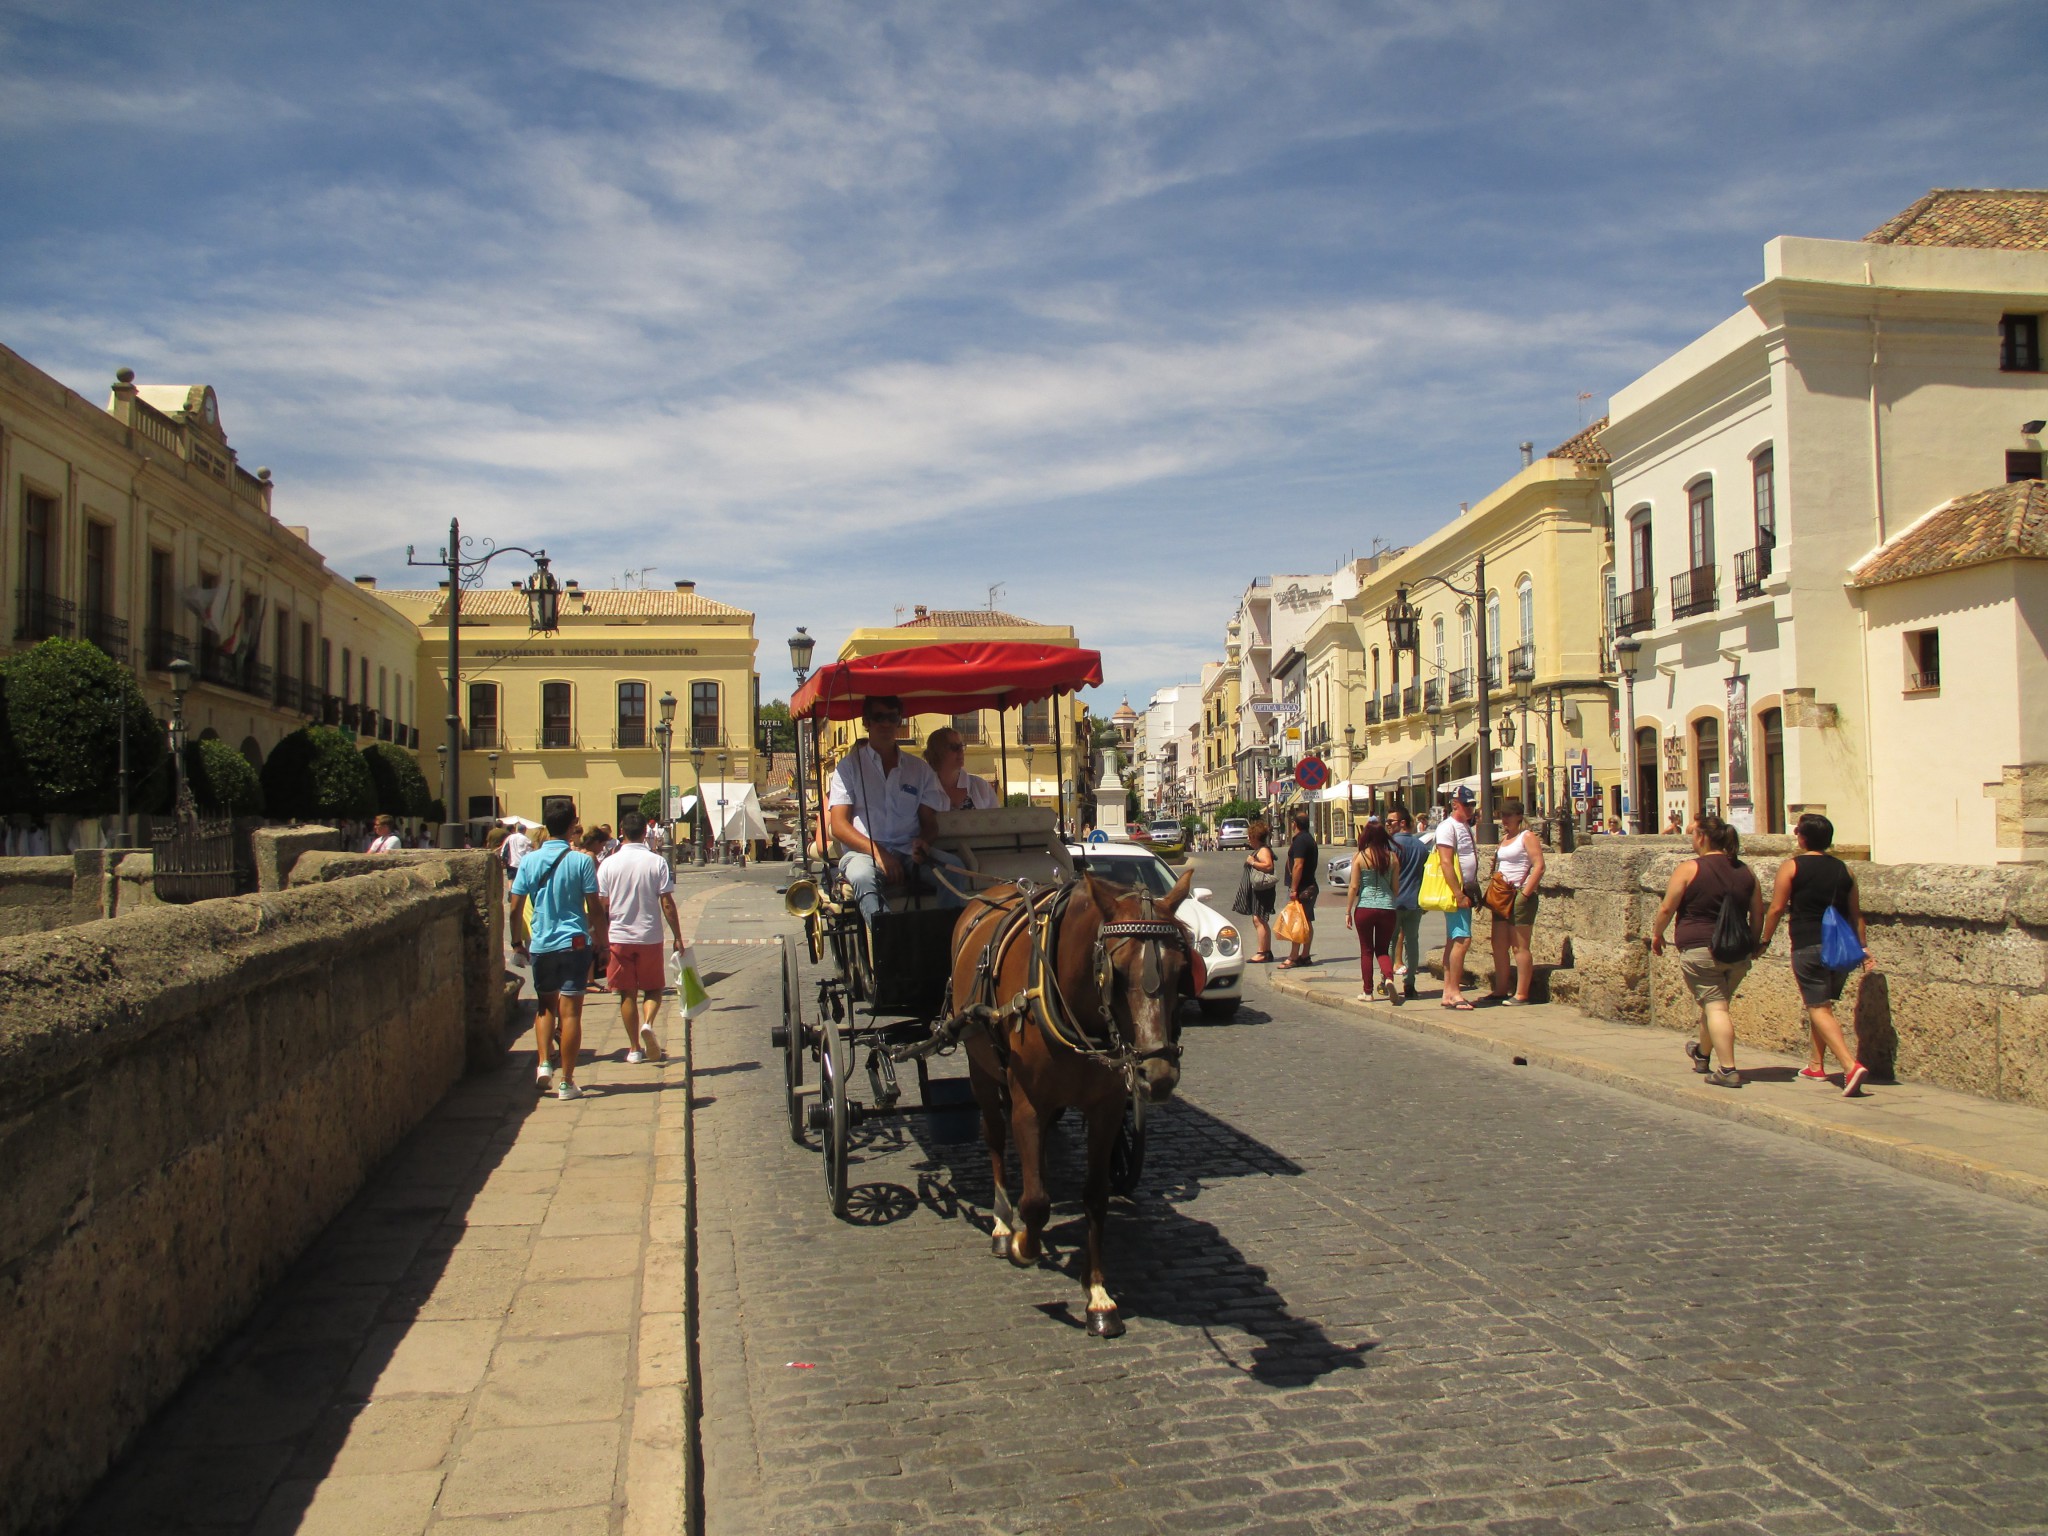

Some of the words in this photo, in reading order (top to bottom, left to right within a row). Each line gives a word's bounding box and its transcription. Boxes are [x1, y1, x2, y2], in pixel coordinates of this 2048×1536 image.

[476, 648, 555, 657] APARTAMENTOS
[561, 648, 619, 657] TURISTICOS
[624, 648, 698, 656] RONDACENTRO
